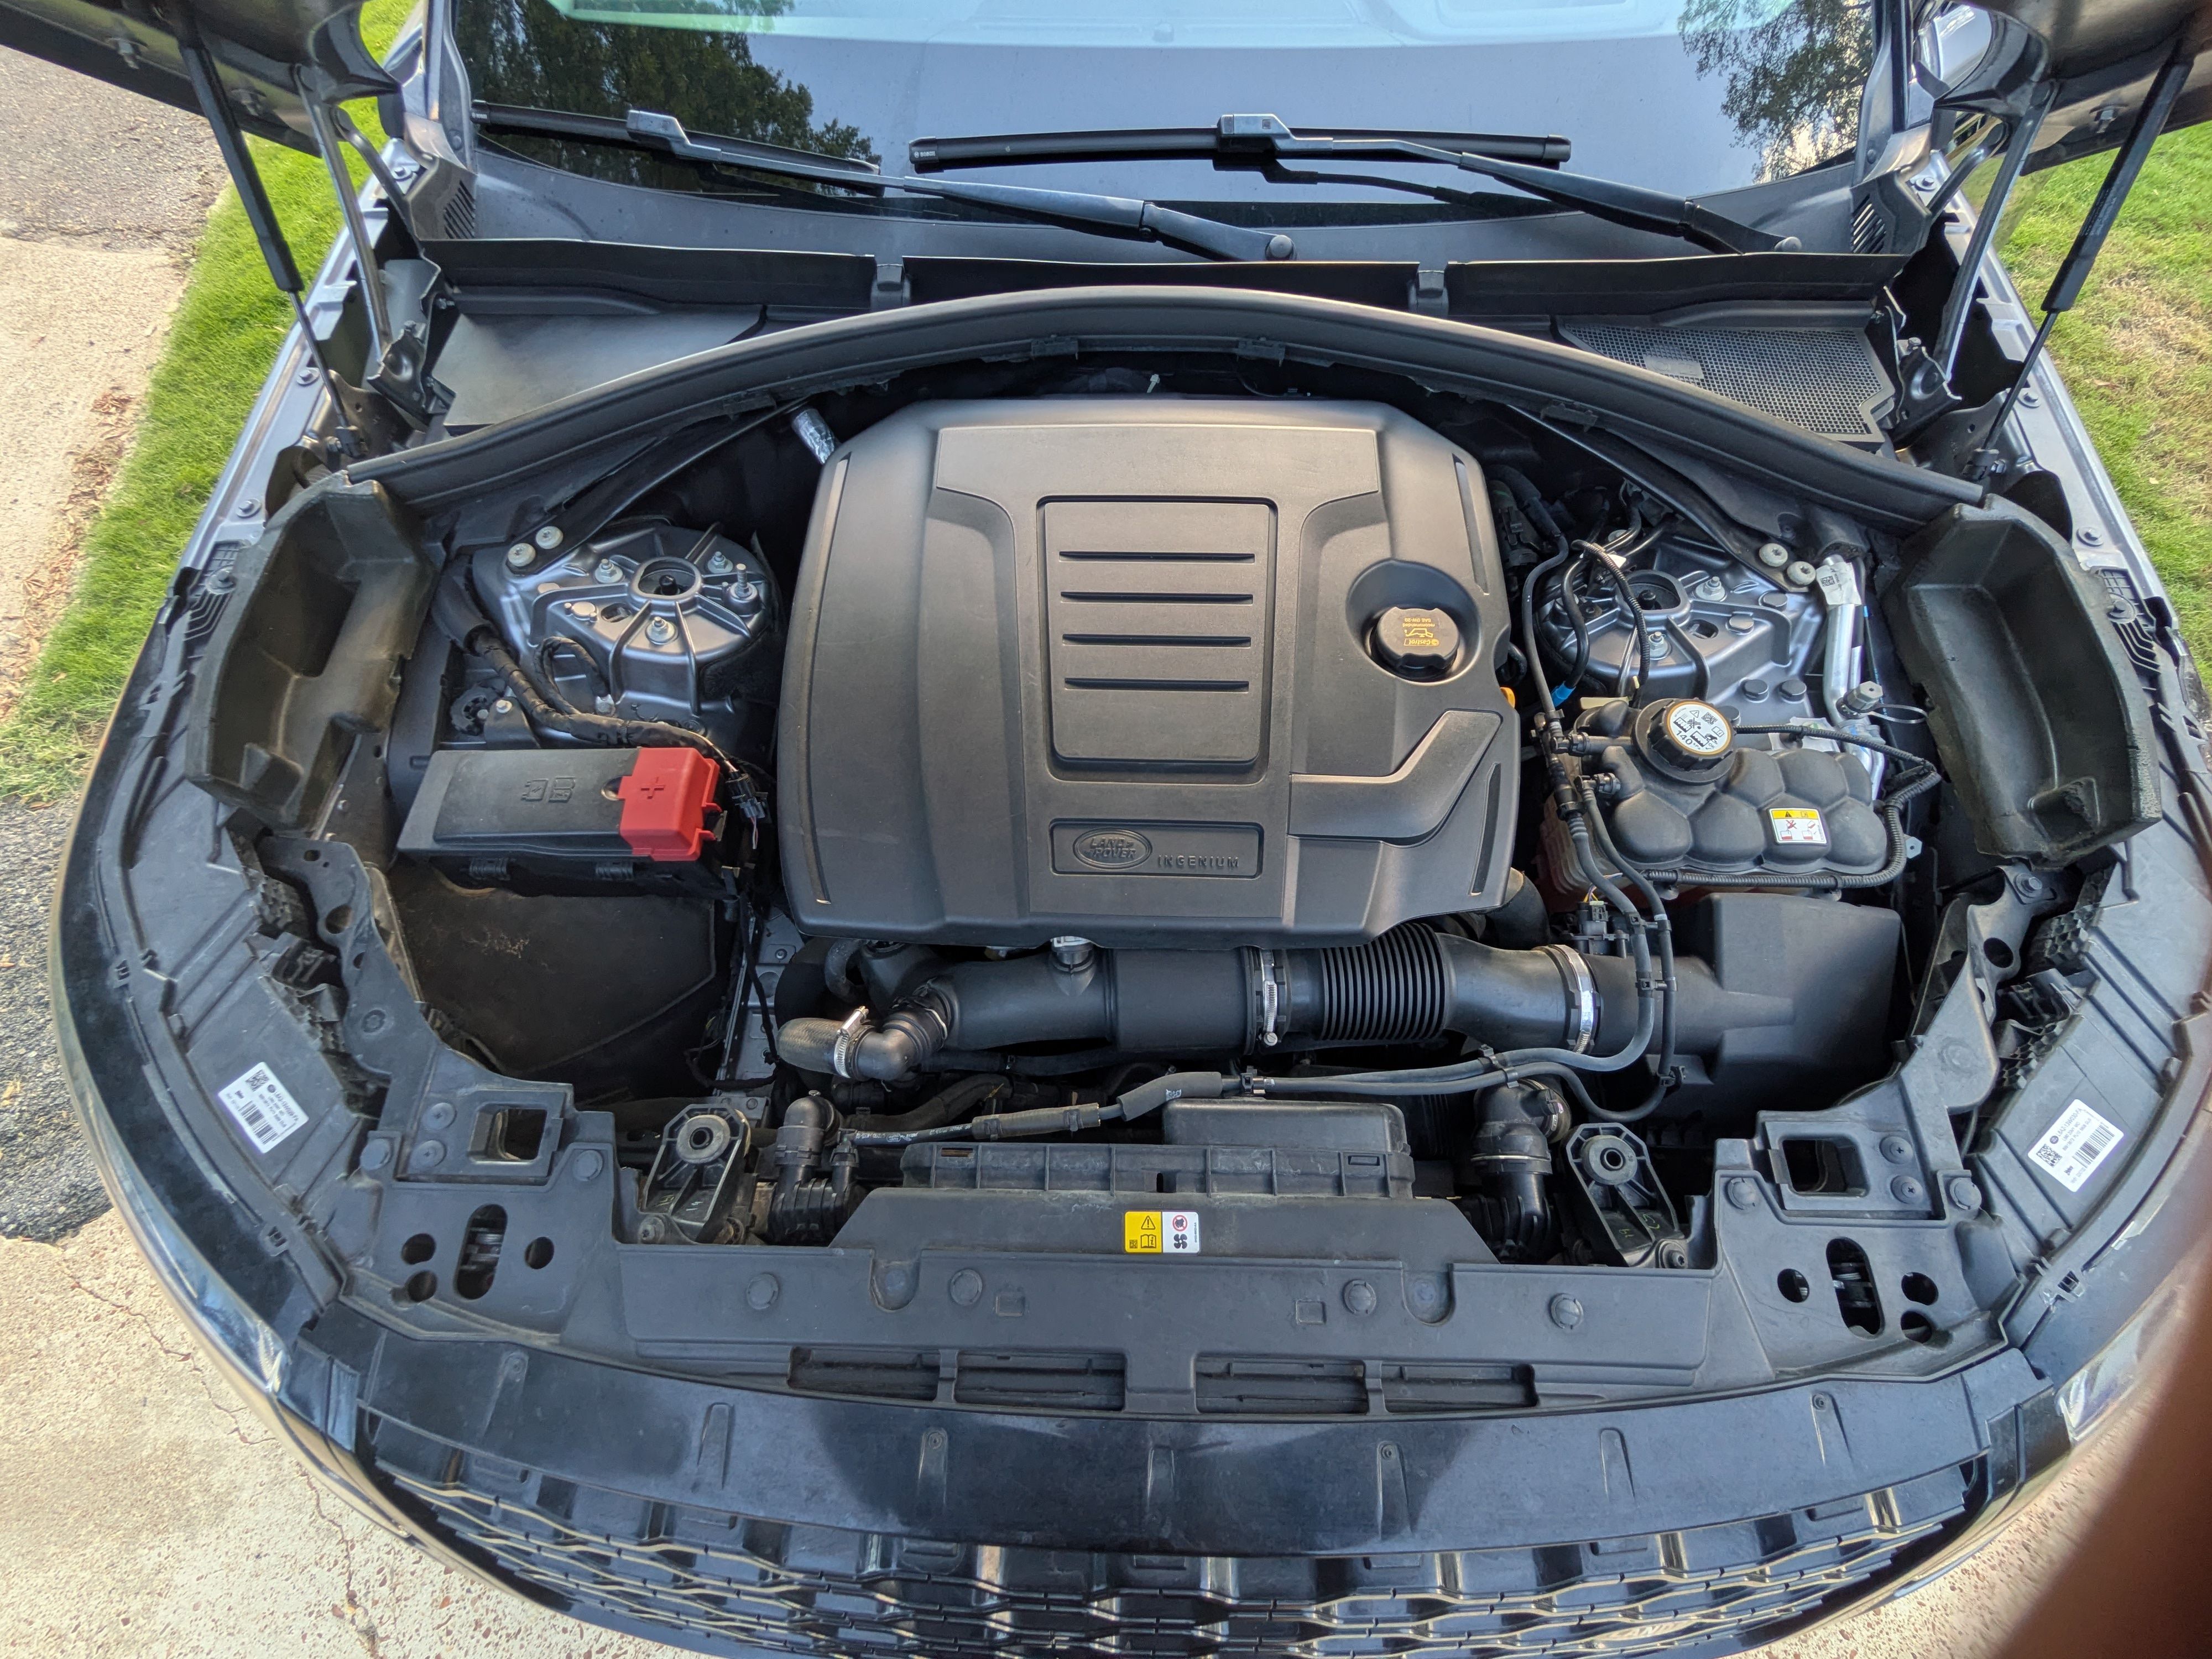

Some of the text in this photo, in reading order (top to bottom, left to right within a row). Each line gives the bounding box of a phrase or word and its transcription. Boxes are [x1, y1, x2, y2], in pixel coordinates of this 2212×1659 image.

[1676, 730, 1693, 745] 140
[1089, 836, 1127, 849] LAND
[1092, 847, 1136, 859] ROVER
[1158, 854, 1240, 868] INGENIUM
